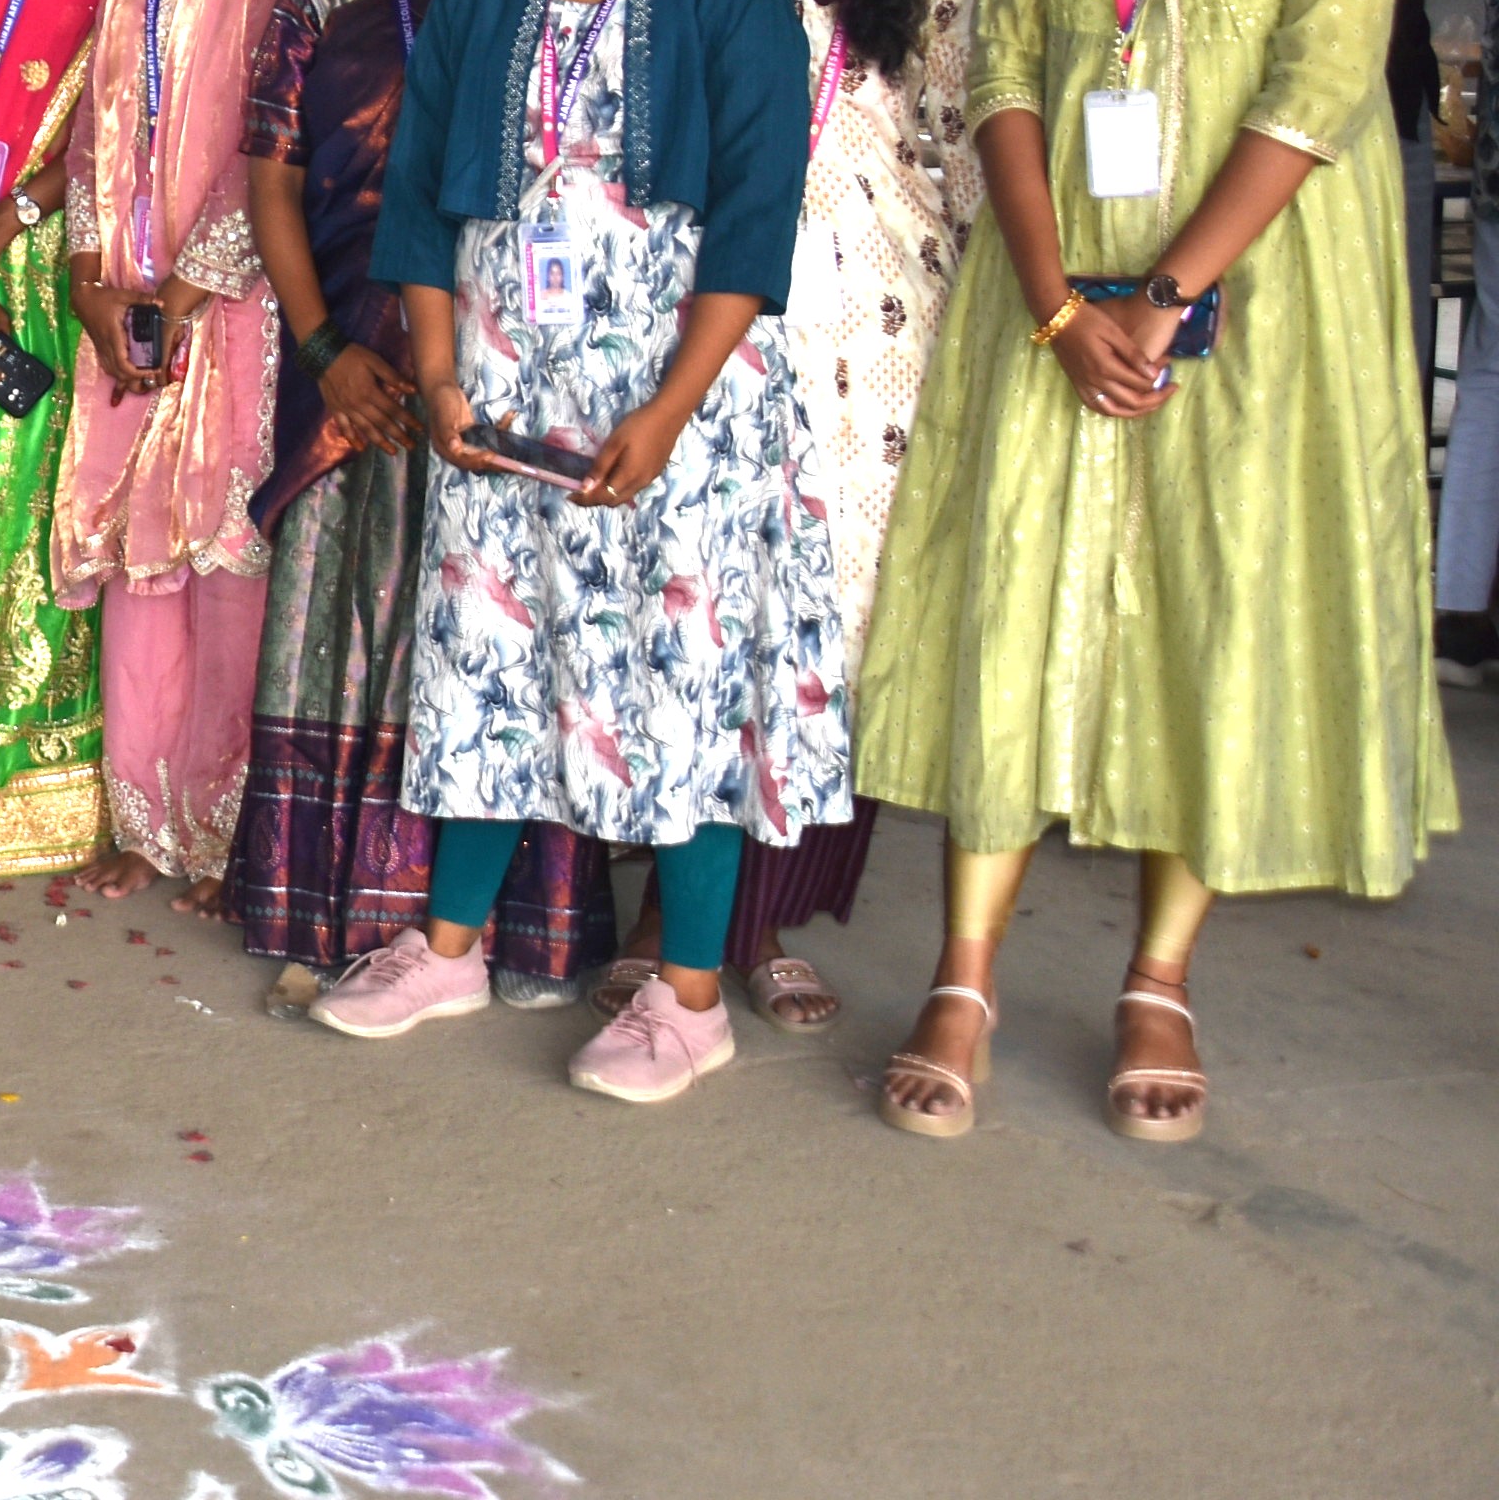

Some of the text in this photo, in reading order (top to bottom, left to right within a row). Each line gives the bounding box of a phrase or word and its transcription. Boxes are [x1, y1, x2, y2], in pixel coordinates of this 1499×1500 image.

[0, 17, 13, 49] JAIRAM
[146, 32, 154, 51] AND
[147, 53, 155, 76] ARTS
[544, 48, 553, 74] ARTS
[559, 79, 577, 120] JAIRAM
[572, 52, 587, 79] ARTS
[583, 30, 598, 51] AND
[815, 82, 831, 120] JAIRAM
[824, 56, 837, 82] ARTS
[831, 33, 841, 55] AND
[149, 78, 158, 112] JAIRAM
[543, 76, 552, 116] JAIRAM
